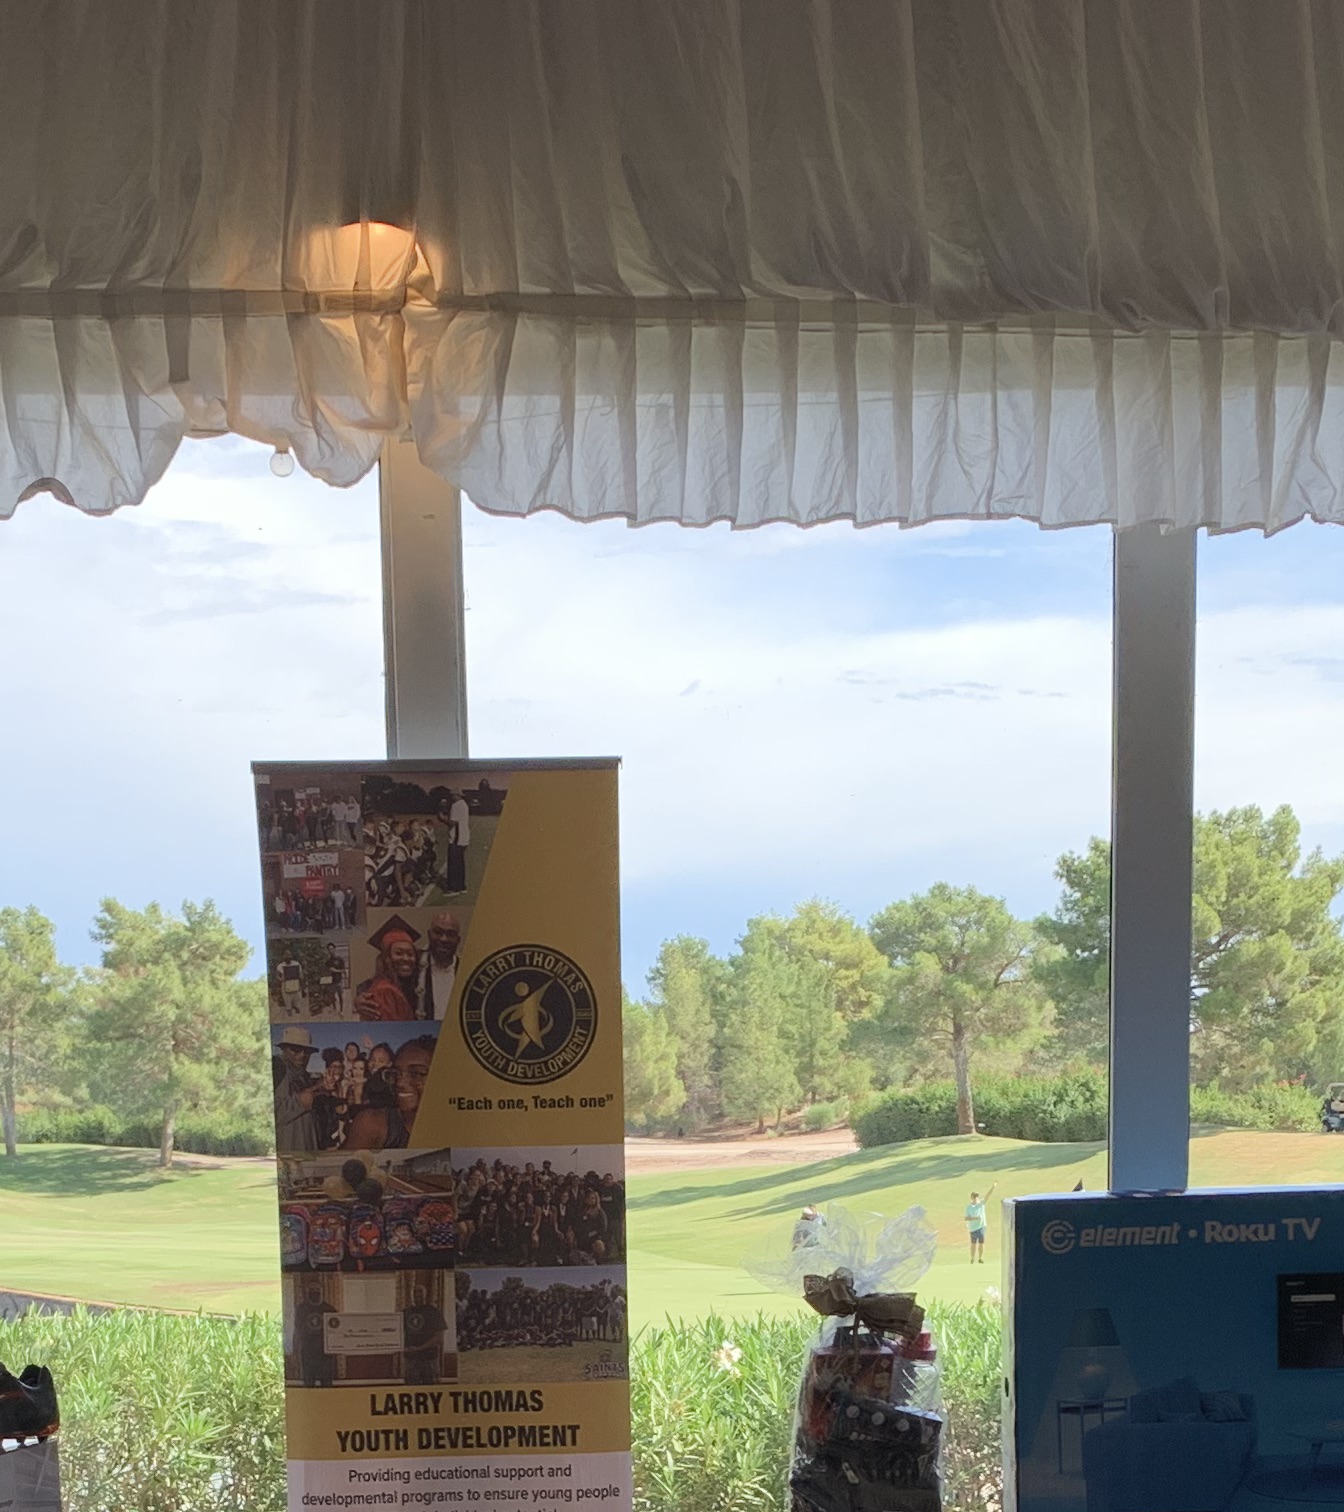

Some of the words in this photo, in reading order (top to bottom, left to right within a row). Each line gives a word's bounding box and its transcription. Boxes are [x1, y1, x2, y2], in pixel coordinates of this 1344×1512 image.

[472, 952, 517, 994] LARRY
[522, 951, 583, 993] THOMAS
[472, 1028, 505, 1068] YOUTH
[507, 1026, 588, 1078] DEVELOPMENT
[498, 1099, 528, 1111] one,
[531, 1095, 575, 1109] Teach
[1078, 1221, 1181, 1247] element
[1281, 1217, 1323, 1241] TV
[585, 1361, 625, 1375] SAINTS
[370, 1393, 443, 1416] LARRY
[449, 1389, 544, 1413] THOMAS
[336, 1428, 409, 1452] YOUTH
[417, 1424, 581, 1450] DEVELOPMENT
[348, 1468, 411, 1485] Providing
[414, 1465, 491, 1481] educational
[493, 1465, 544, 1482] support
[547, 1464, 572, 1478] and
[301, 1490, 398, 1509] developmental
[402, 1490, 463, 1507] programs
[467, 1488, 481, 1502] to
[483, 1488, 528, 1501] ensure
[531, 1486, 573, 1502] young
[576, 1484, 621, 1500] people
